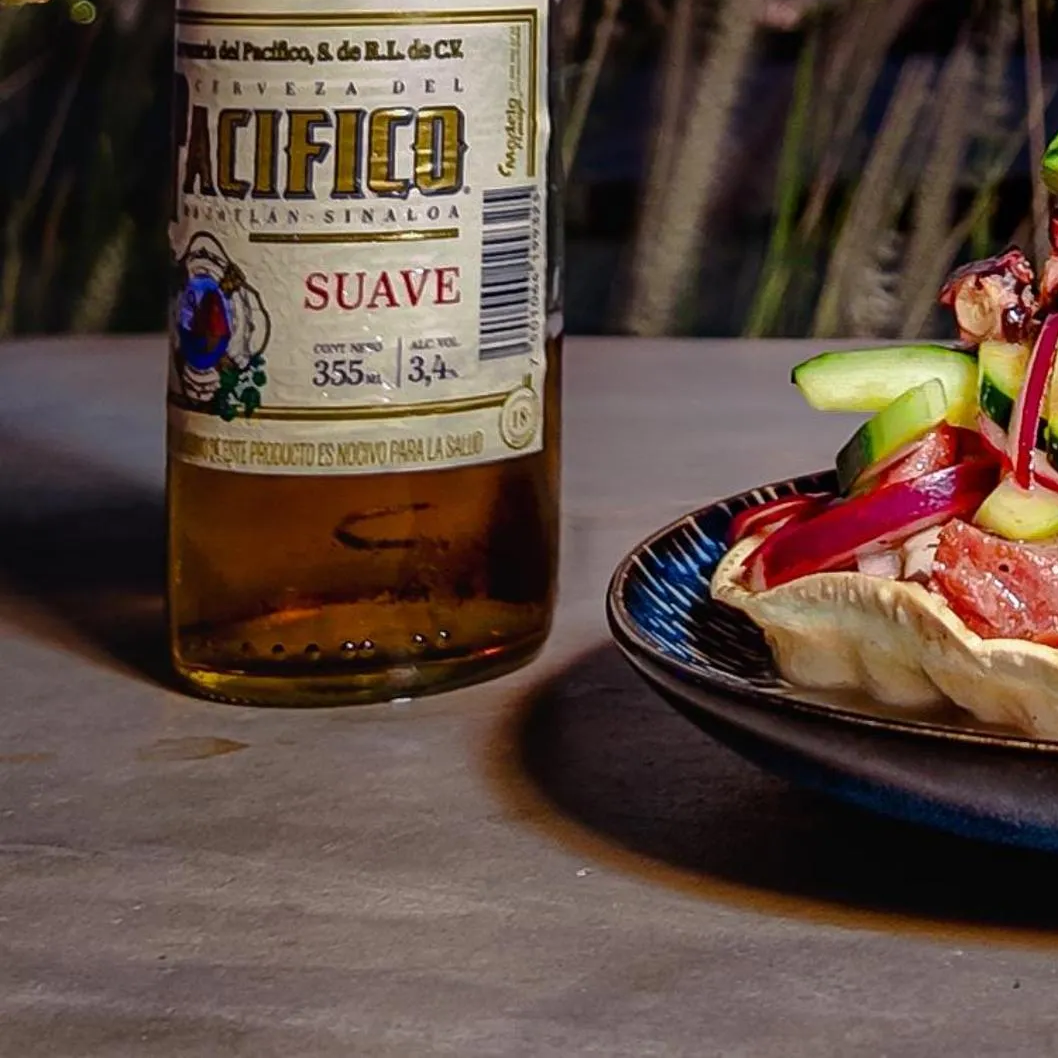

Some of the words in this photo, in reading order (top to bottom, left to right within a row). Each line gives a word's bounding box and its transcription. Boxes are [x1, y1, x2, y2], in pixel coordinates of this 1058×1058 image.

[337, 39, 361, 61] de
[407, 38, 432, 60] de
[194, 79, 357, 96] CERVEZA
[392, 77, 464, 95] DEL
[172, 73, 468, 224] ACIFICO
[322, 204, 460, 224] SINALOA
[303, 266, 462, 311] SUAVE
[250, 440, 316, 467] PRODUCTO
[318, 442, 334, 468] ES
[336, 440, 388, 467] NOCIVO
[389, 438, 426, 464] PARA
[426, 437, 445, 462] LA
[445, 430, 484, 460] SALUD
